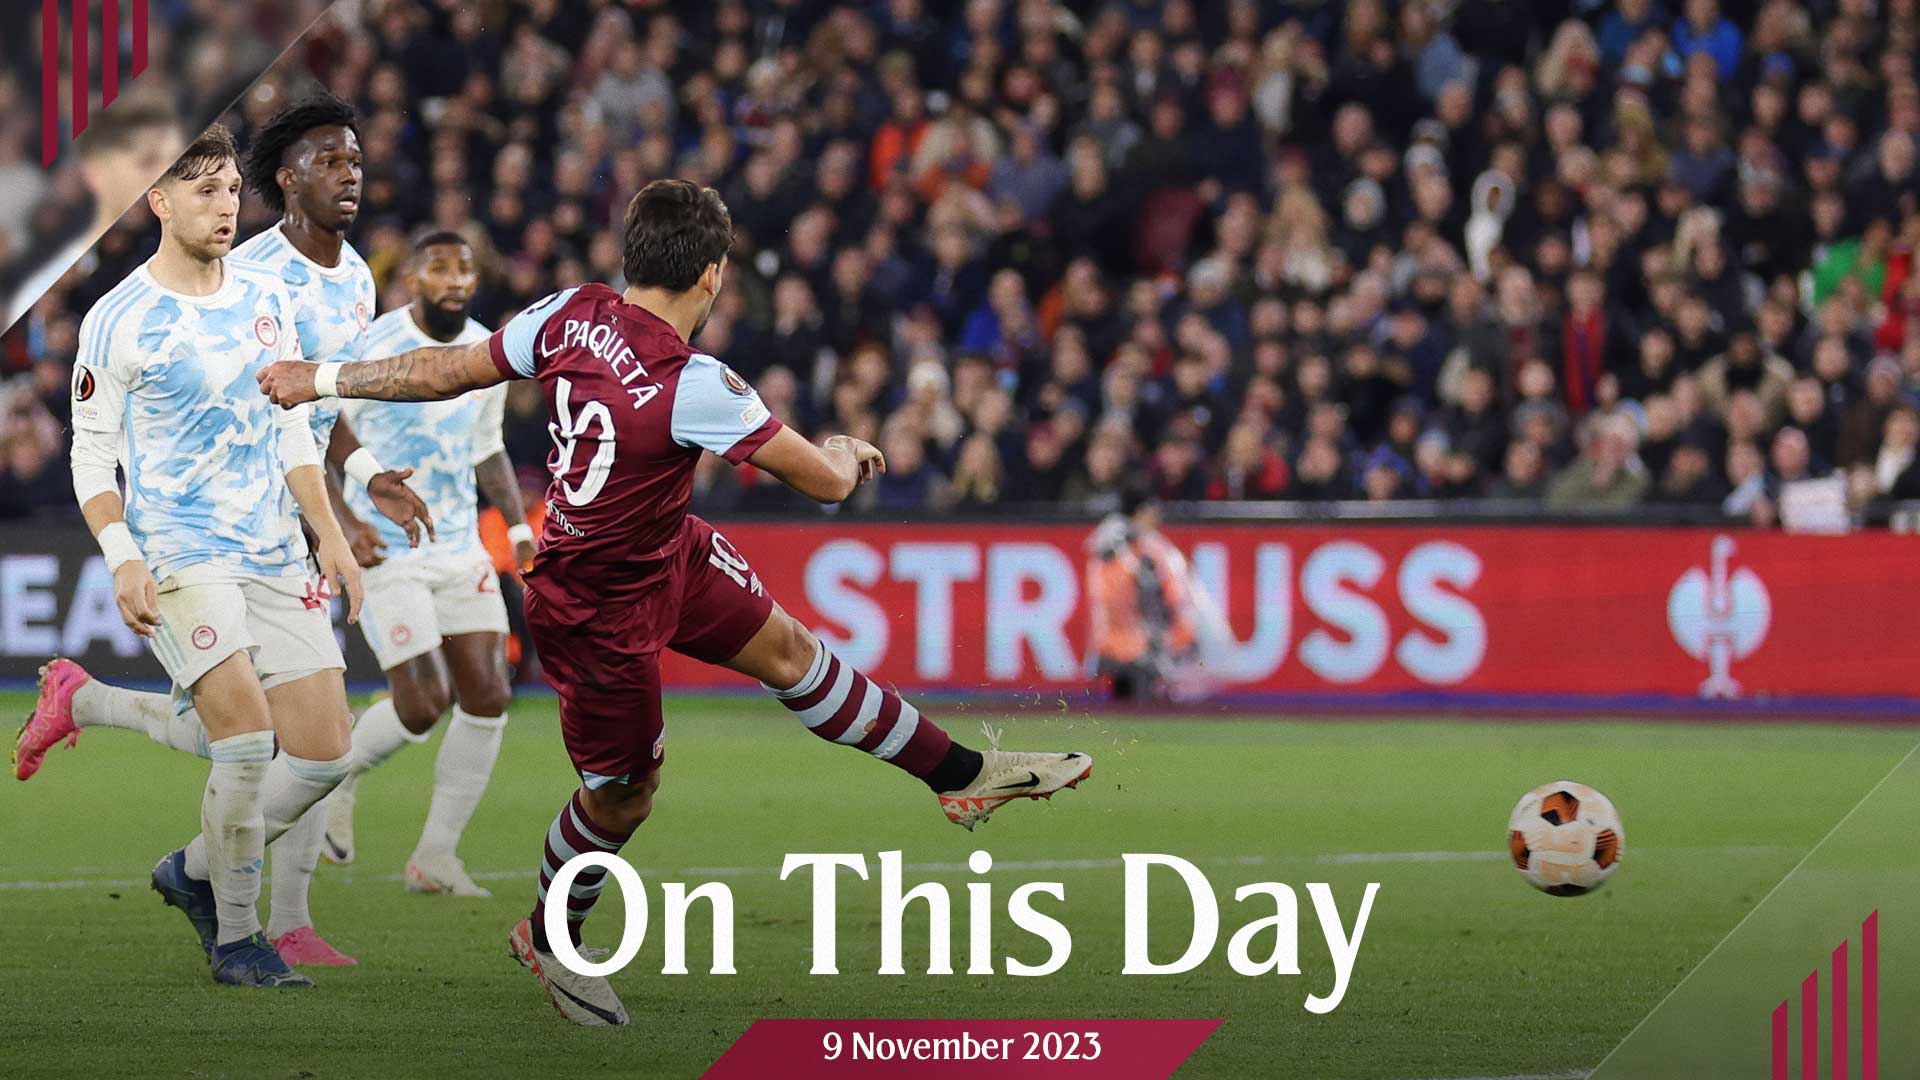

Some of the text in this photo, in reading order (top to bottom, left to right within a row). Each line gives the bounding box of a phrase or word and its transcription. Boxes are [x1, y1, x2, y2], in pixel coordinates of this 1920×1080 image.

[541, 319, 664, 410] L.PAQUETÁ
[708, 532, 749, 588] 10
[805, 539, 1487, 684] STRUSS
